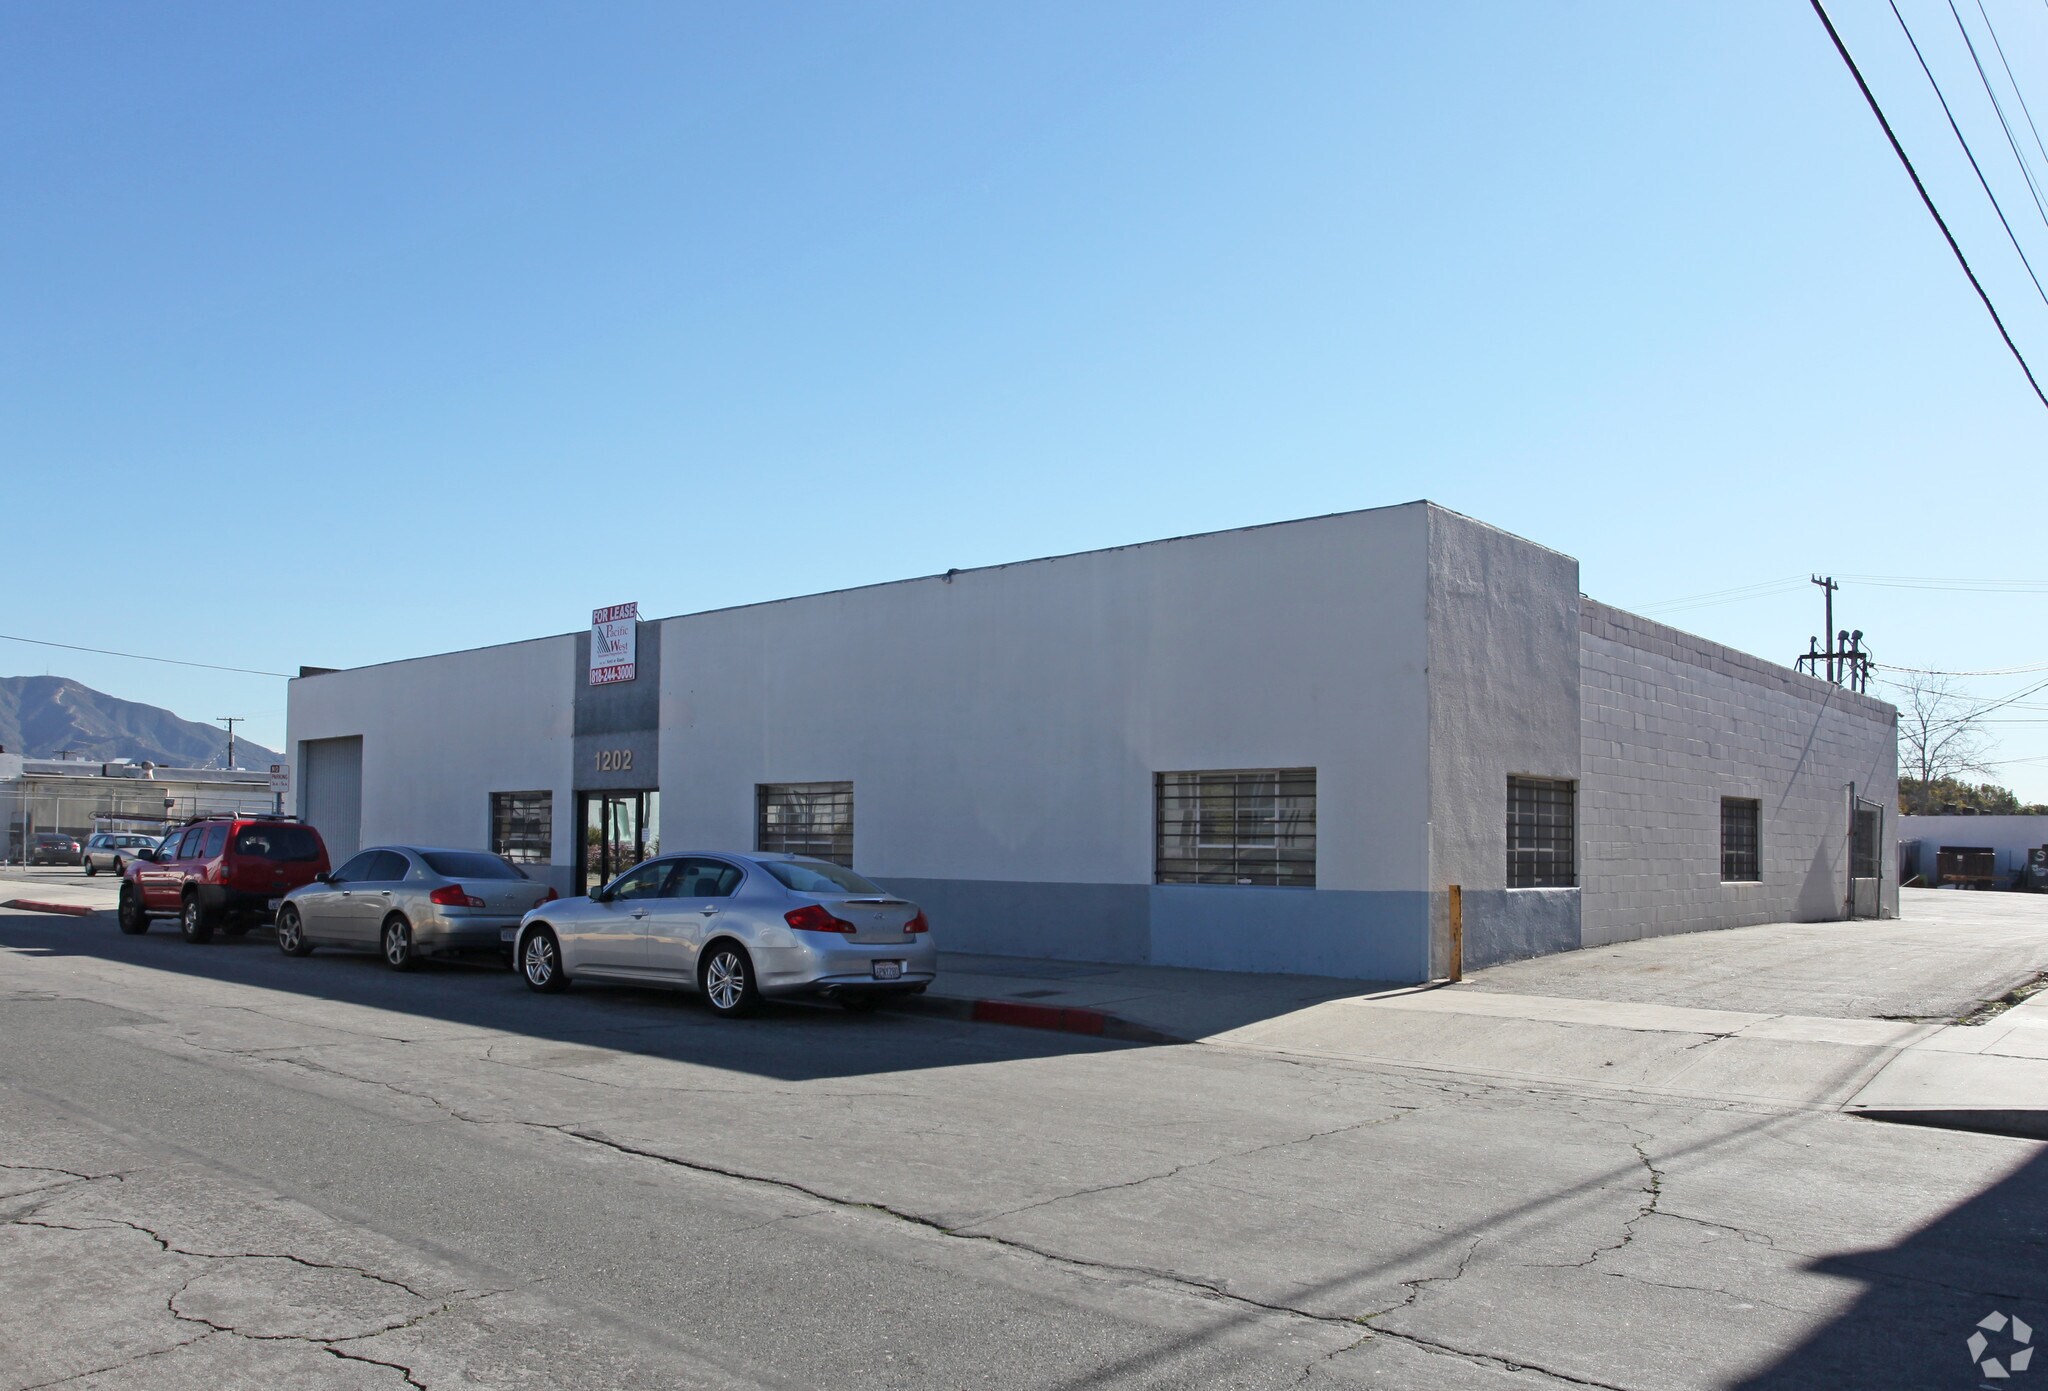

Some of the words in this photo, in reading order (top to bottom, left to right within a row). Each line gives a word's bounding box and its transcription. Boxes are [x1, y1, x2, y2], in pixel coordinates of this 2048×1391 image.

[593, 609, 608, 624] FOR
[610, 603, 635, 620] LEASE
[606, 624, 629, 638] Pacific
[610, 639, 628, 652] West
[591, 665, 633, 684] 818-244-3000
[594, 749, 632, 771] 1202
